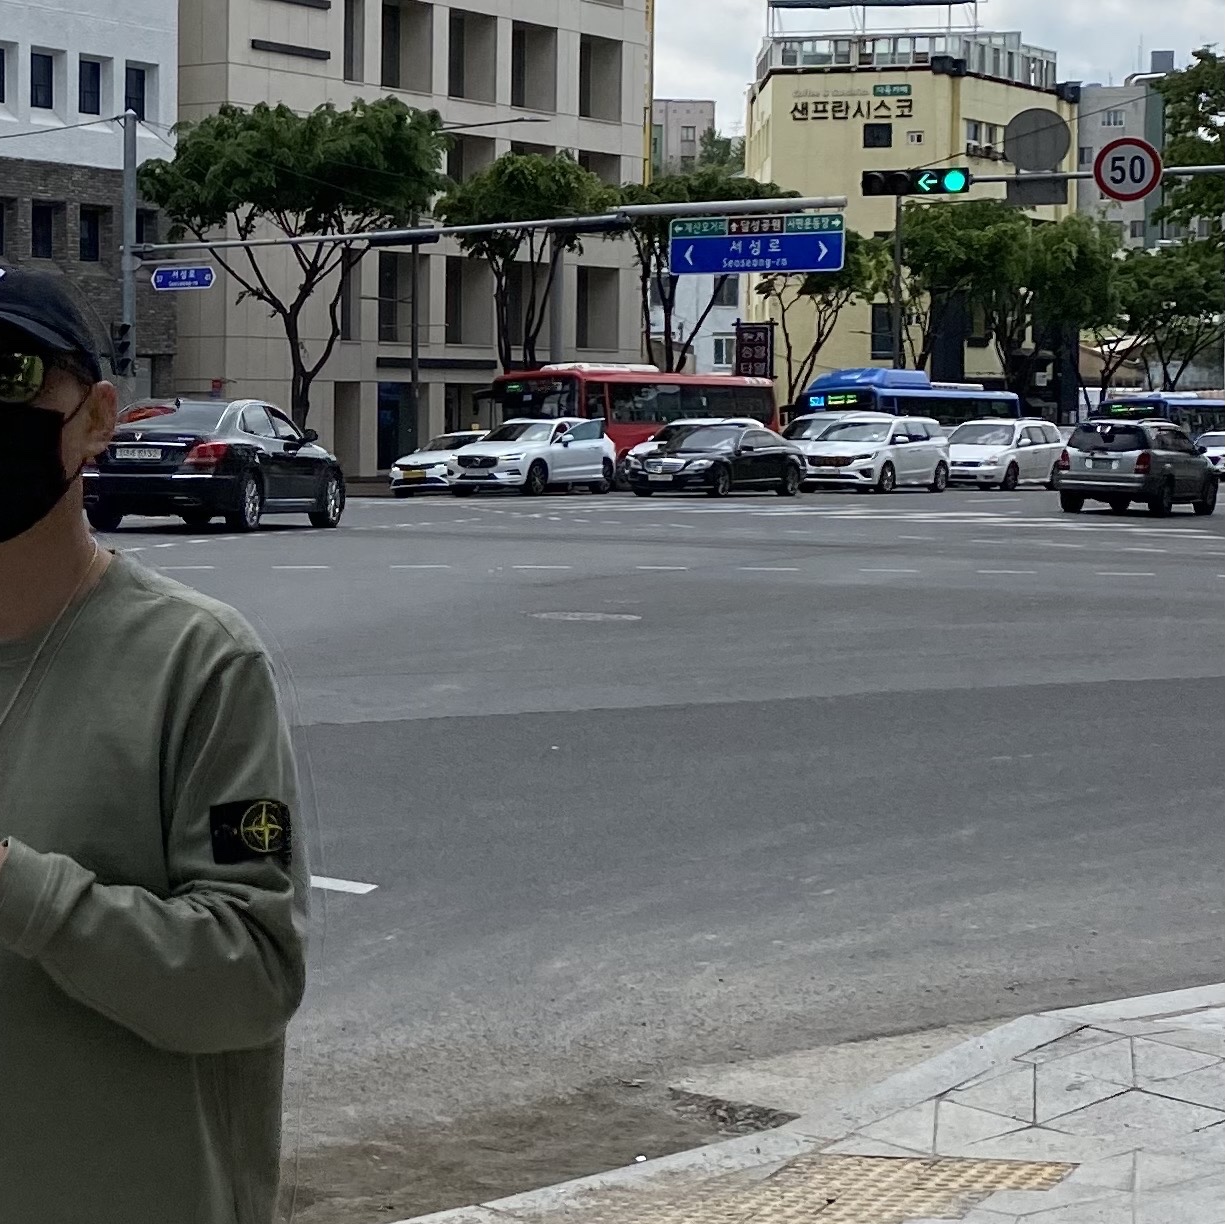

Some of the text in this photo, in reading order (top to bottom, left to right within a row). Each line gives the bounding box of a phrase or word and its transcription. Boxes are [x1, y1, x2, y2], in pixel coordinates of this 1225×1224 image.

[790, 99, 913, 121] 샌프란시스코
[1109, 155, 1145, 184] 50
[740, 217, 781, 233] 달성공원
[729, 238, 782, 256] 서성로
